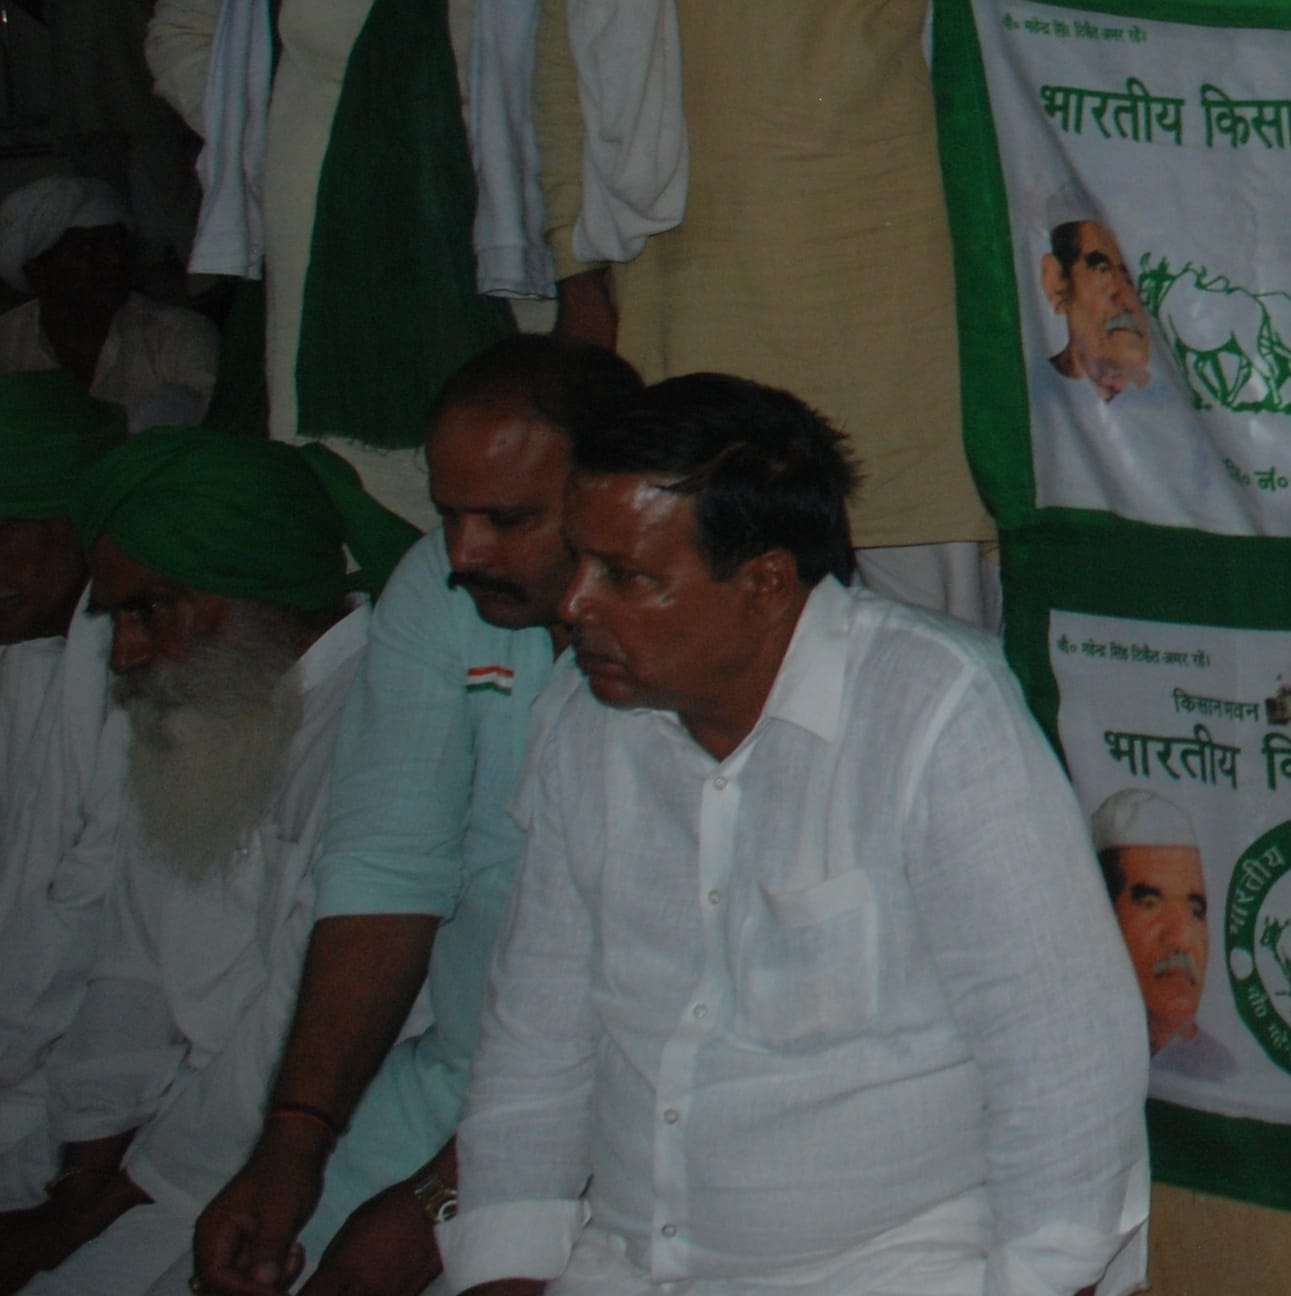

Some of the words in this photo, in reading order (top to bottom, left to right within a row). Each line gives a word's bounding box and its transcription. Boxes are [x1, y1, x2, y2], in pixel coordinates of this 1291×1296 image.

[1040, 77, 1184, 145] भारतीय
[1104, 724, 1241, 790] भारतीय
[1230, 846, 1287, 936] भारतीय
